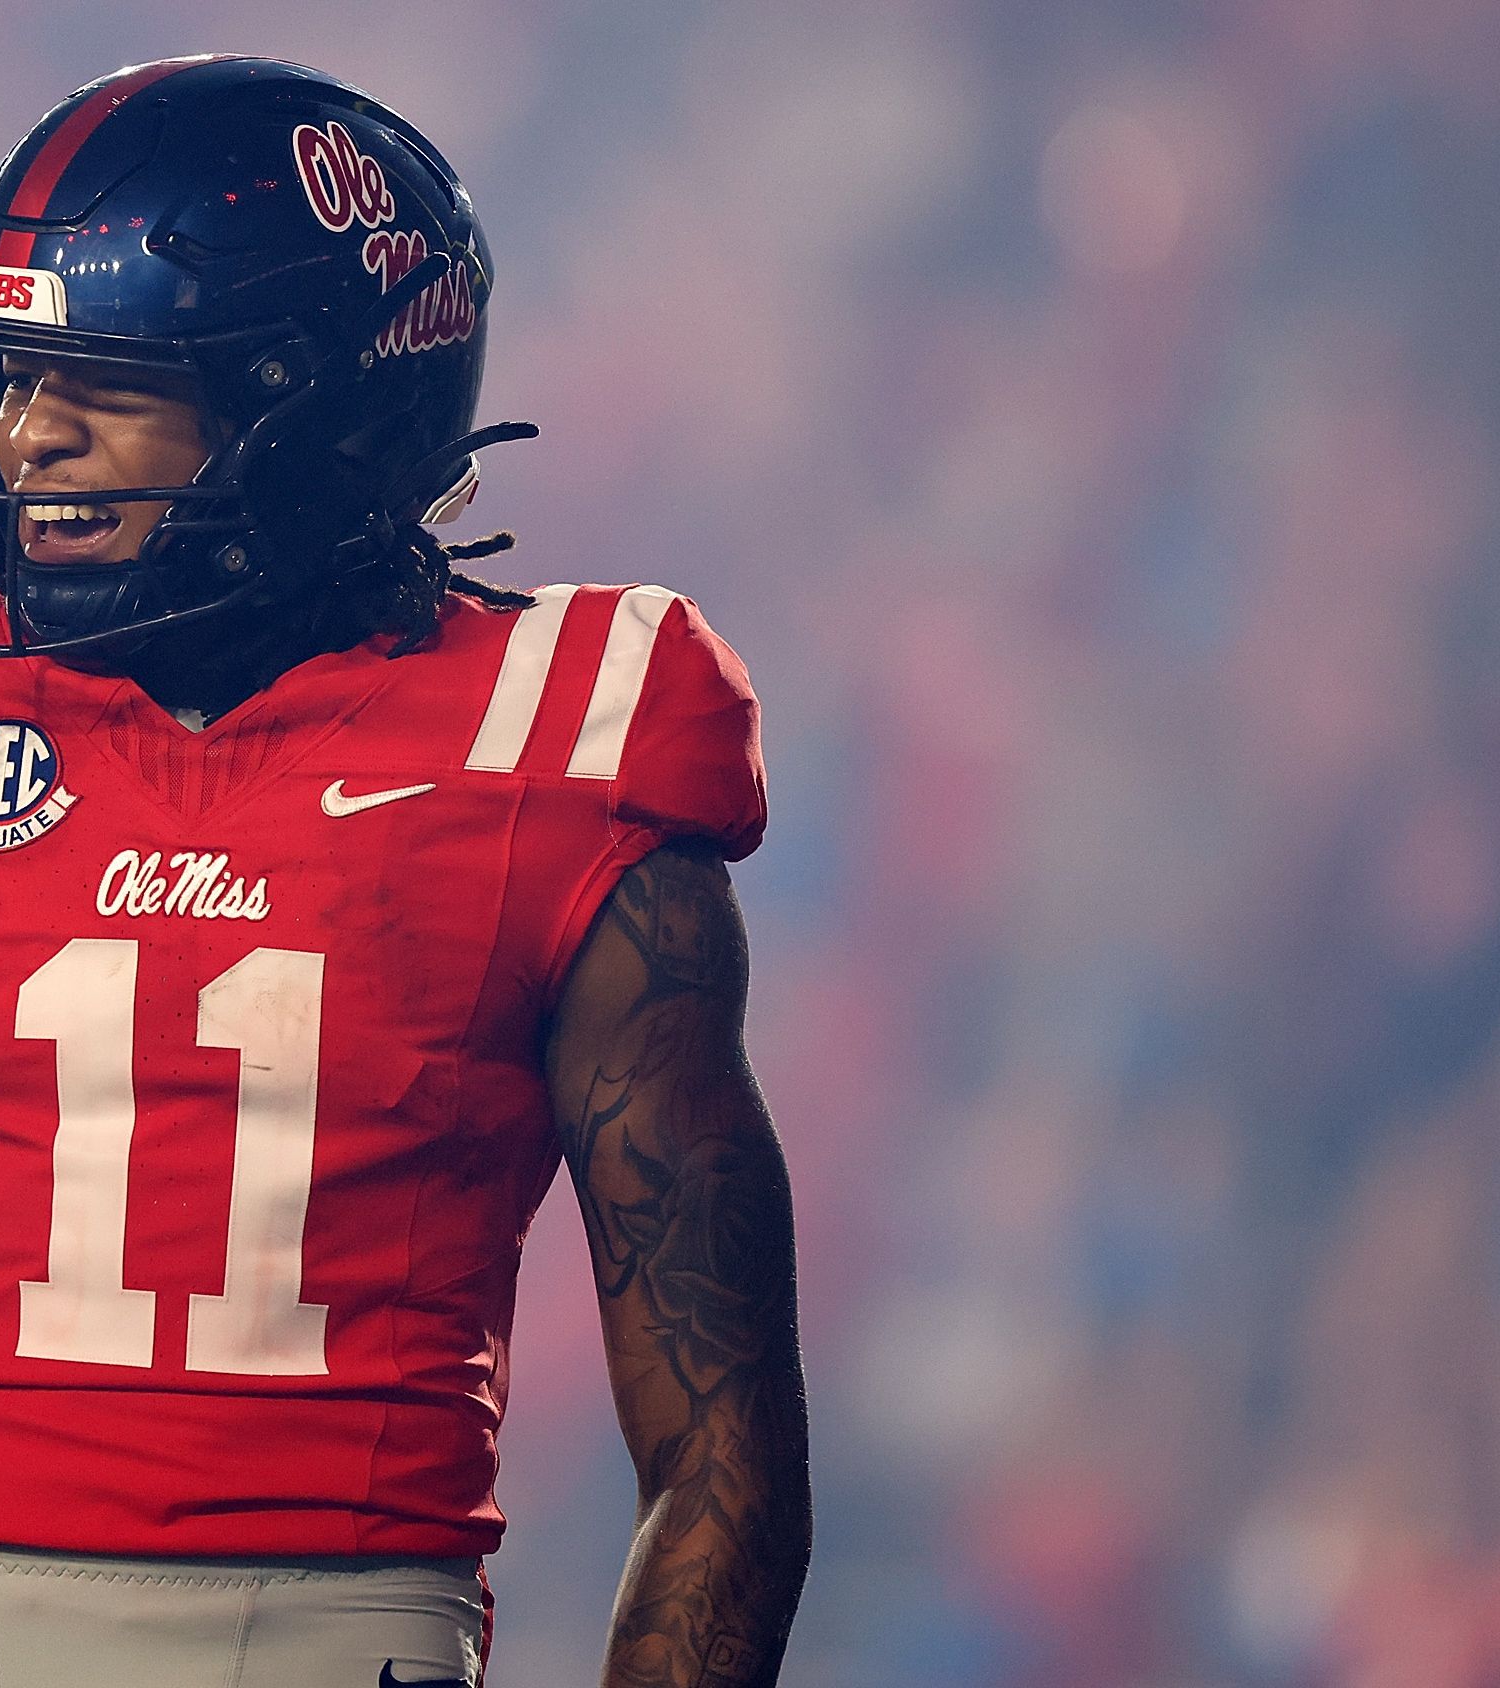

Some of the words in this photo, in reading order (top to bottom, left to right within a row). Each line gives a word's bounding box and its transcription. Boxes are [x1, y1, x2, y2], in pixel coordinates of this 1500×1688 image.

[293, 121, 395, 232] Ole
[96, 849, 162, 916] Ole
[164, 852, 271, 921] Miss
[13, 937, 330, 1376] 11
